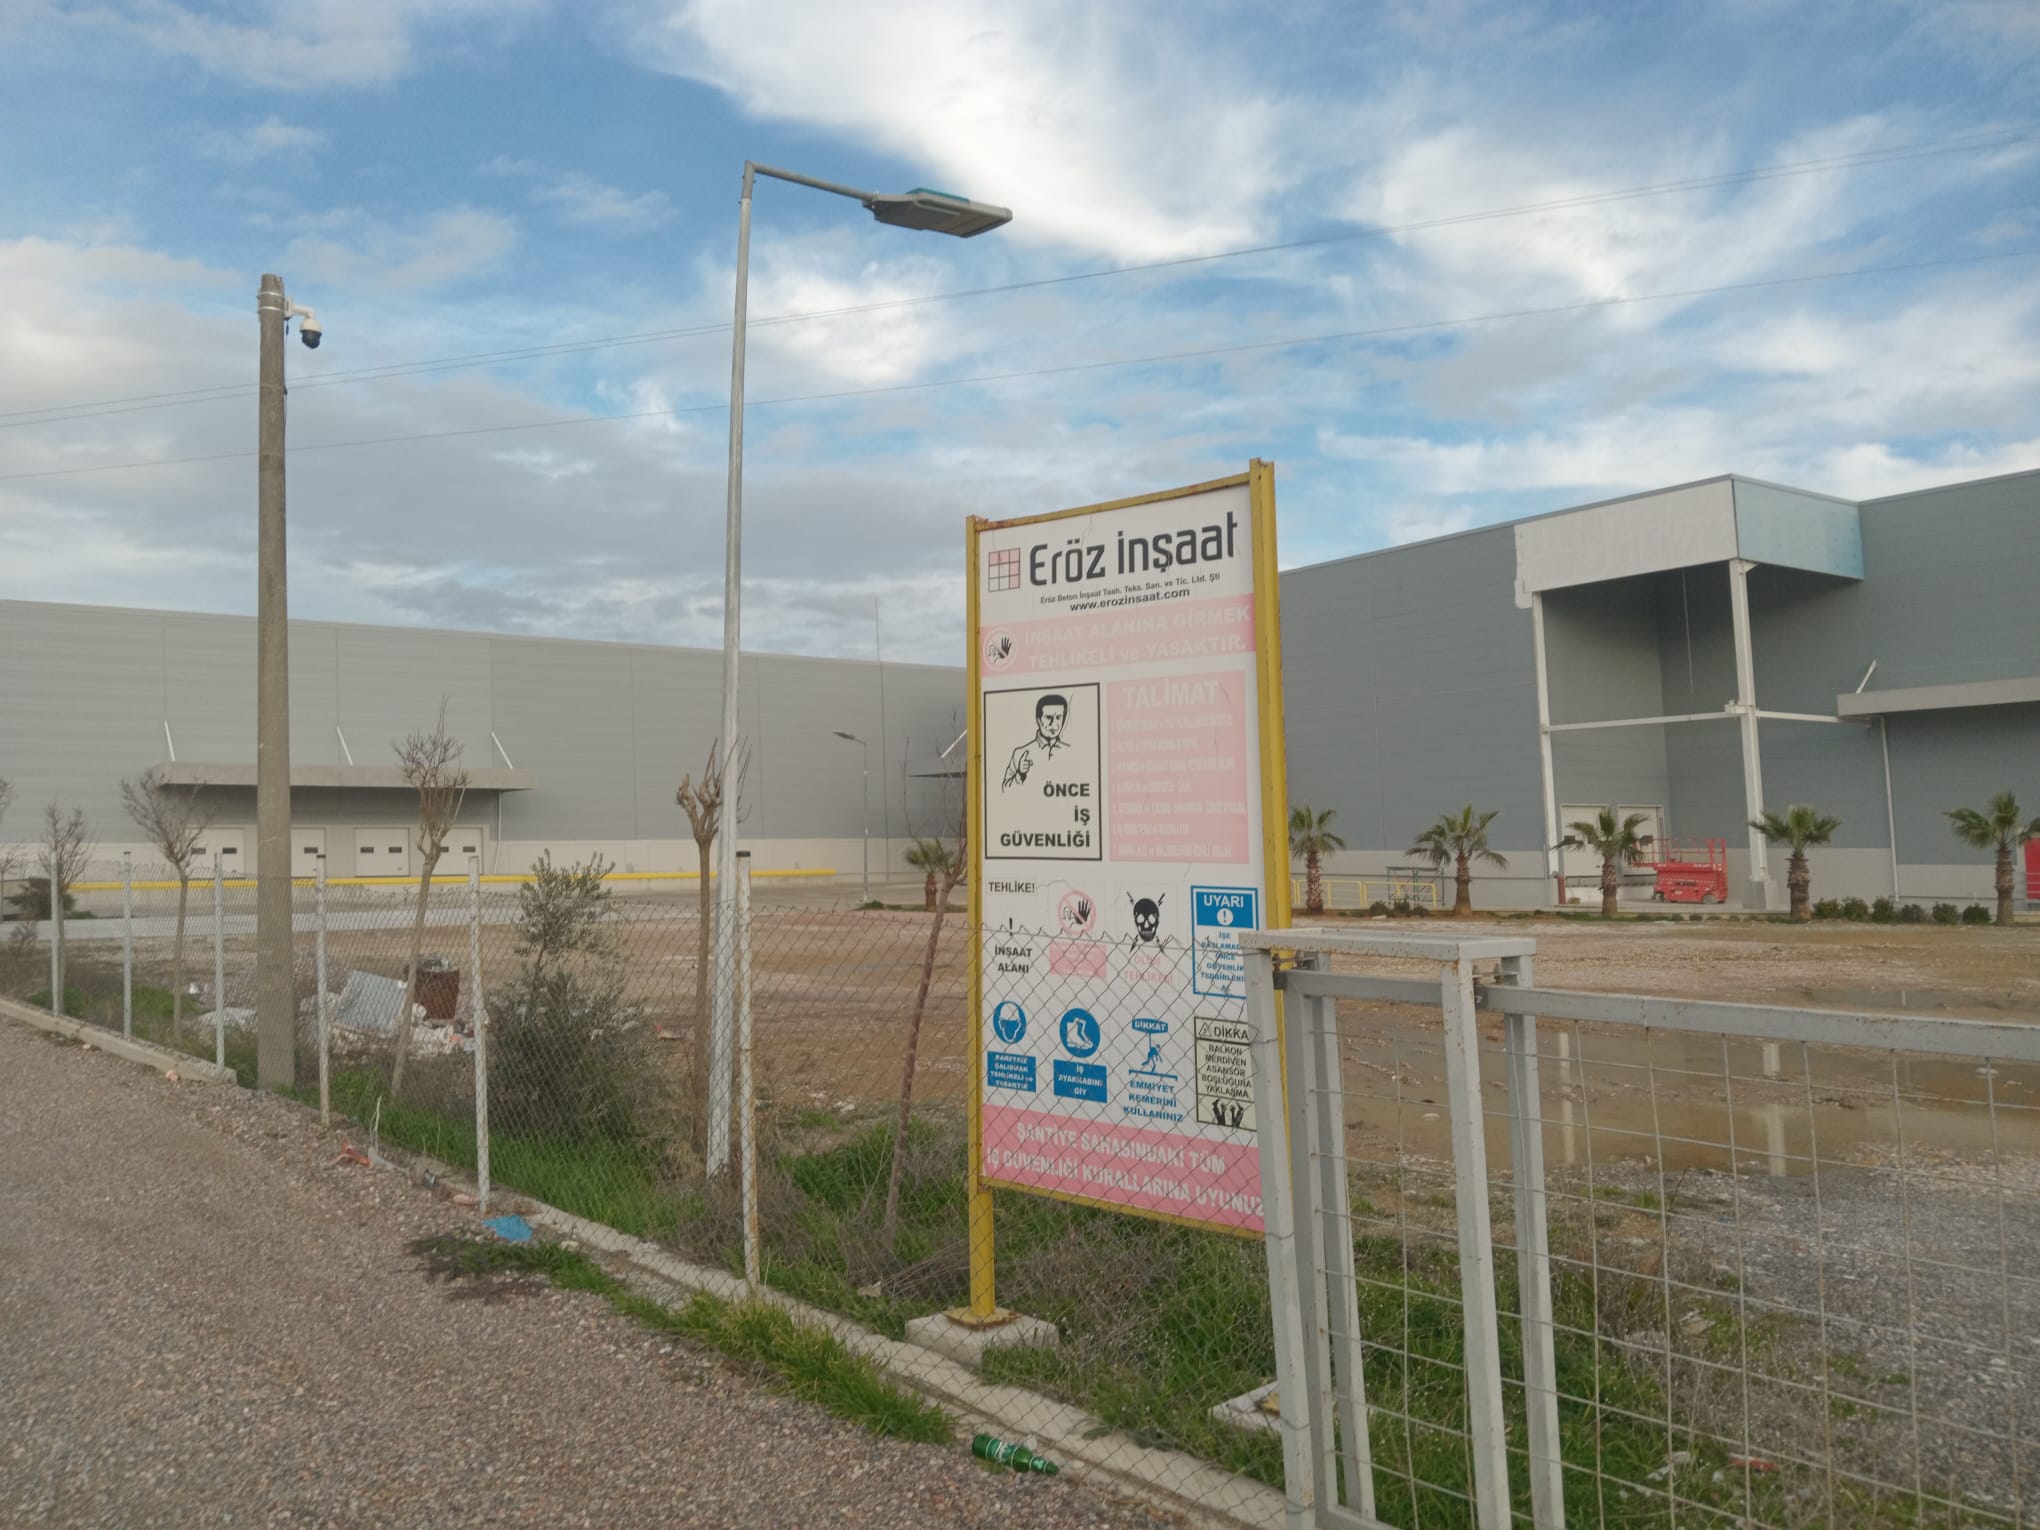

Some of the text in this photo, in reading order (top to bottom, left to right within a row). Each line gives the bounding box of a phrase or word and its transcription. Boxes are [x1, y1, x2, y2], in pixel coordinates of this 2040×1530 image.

[1030, 538, 1106, 586] Eröz
[1145, 582, 1161, 591] San.
[1176, 577, 1189, 586] Tic.
[1191, 574, 1207, 584] Ltd.
[1070, 588, 1190, 612] www.erozinsaat.com
[1174, 605, 1250, 630] GİRMEK
[1030, 646, 1114, 672] TEHLİKELİ
[1144, 634, 1246, 659] YASAKTIR.
[1122, 679, 1219, 710] TALİMAT
[1043, 780, 1090, 797] ÖNCE
[1074, 804, 1091, 826] İŞ
[1000, 830, 1091, 848] GÜVENLİĞİ
[988, 881, 1035, 893] TEHLİKE!
[1203, 894, 1244, 908] UYARI
[994, 944, 1032, 958] İNŞAAT
[998, 962, 1030, 974] ALANI
[1134, 1019, 1166, 1031] DİKKAT
[1214, 1025, 1250, 1040] DİKKA
[1208, 1044, 1243, 1056] BALKON
[1205, 1054, 1247, 1067] MERDİVEN
[1206, 1064, 1246, 1077] ASANSÖR
[1206, 1084, 1249, 1098] YAKLAŞMA
[1128, 1093, 1177, 1108] KEMERİNİ
[1123, 1106, 1183, 1122] KULLANINIZ
[1016, 1121, 1226, 1176] ŞANTİYE SAHASINDAKİ TÜM
[987, 1146, 999, 1169] İŞ
[1003, 1150, 1078, 1180] GÜVENLİĞİ
[1082, 1165, 1191, 1202] KURALLARINA
